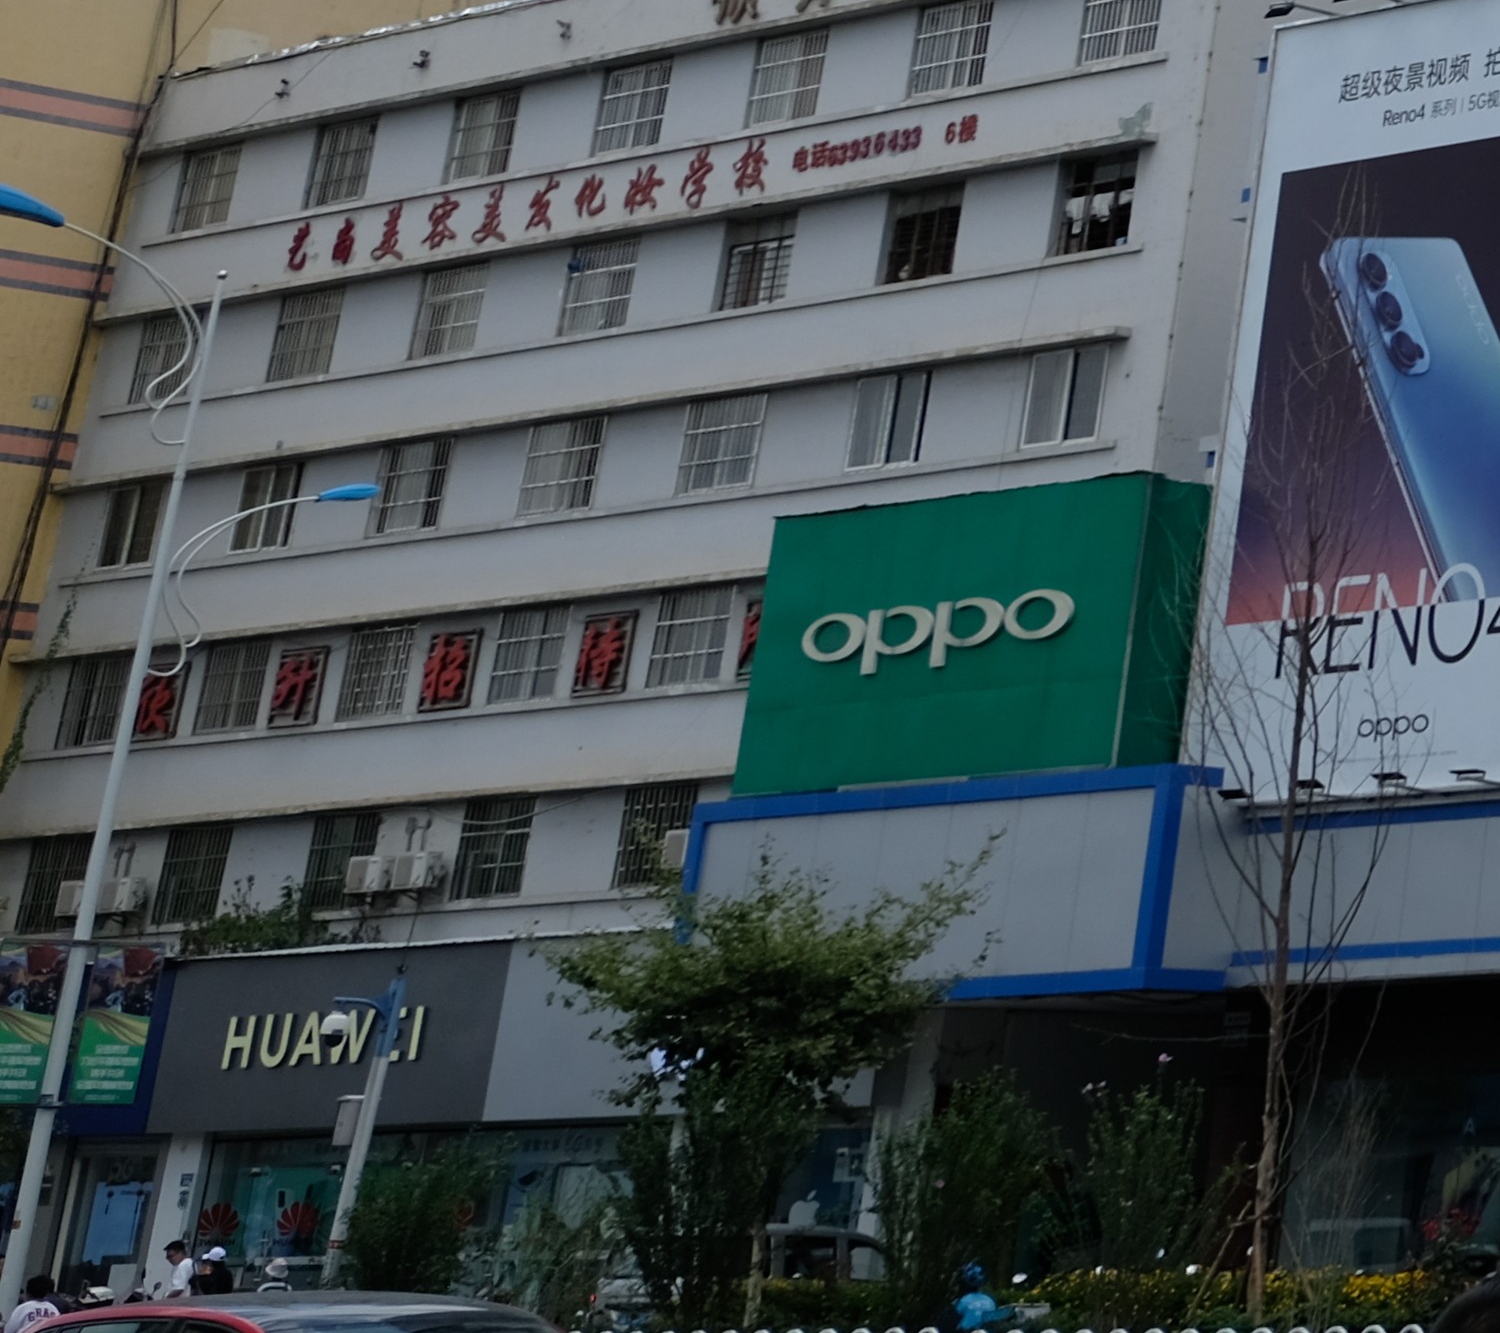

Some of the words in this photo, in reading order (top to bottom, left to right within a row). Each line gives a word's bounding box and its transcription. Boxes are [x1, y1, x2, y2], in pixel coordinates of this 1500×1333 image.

[1338, 53, 1472, 104] 超级夜景视频
[1382, 104, 1426, 127] Reno4
[1430, 98, 1457, 119] 系列
[802, 588, 1075, 675] oppo
[1357, 713, 1430, 743] oppo
